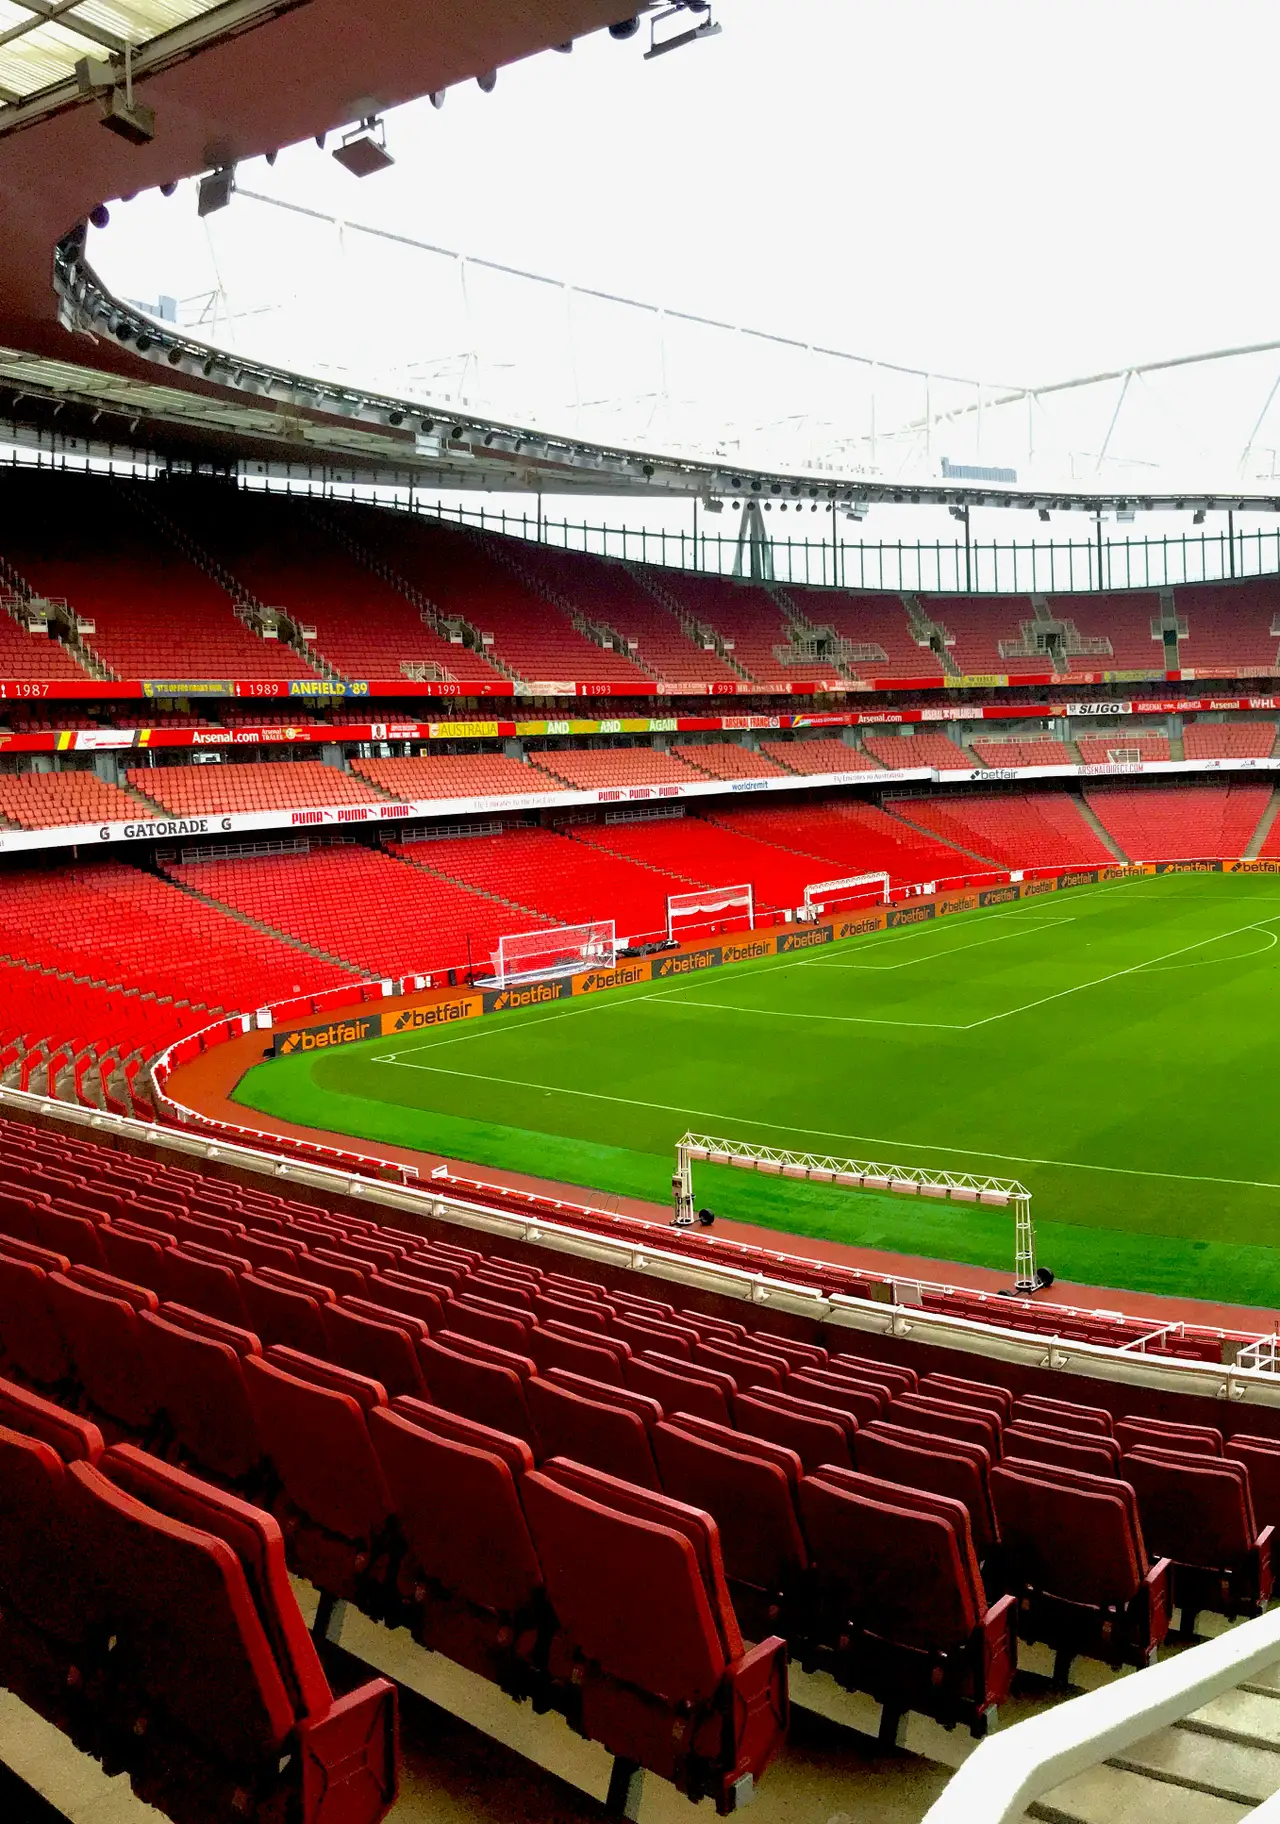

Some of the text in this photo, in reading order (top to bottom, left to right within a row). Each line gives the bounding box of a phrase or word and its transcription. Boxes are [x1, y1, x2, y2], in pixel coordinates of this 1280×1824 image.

[15, 684, 49, 696] 1987
[249, 684, 279, 695] 1989
[291, 682, 368, 695] ANFIELD '89
[437, 685, 461, 695] 1991
[591, 685, 611, 695] 1993
[1079, 703, 1119, 714] SLIGO
[1210, 700, 1240, 709] Arsenal
[1250, 698, 1277, 708] WHL
[649, 719, 677, 731] AGAIN
[858, 714, 902, 723] Arsenal.com
[441, 723, 497, 736] AUSTRALIA
[547, 721, 570, 734] AND
[600, 720, 621, 733] AND
[192, 730, 259, 744] Arsenal.com
[981, 769, 1018, 779] betfair
[659, 787, 678, 797] PUMA
[732, 781, 768, 791] worldremit
[598, 790, 620, 801] PUMA
[629, 788, 650, 799] PUMA
[292, 811, 322, 824] PUMA
[338, 808, 367, 821] PUMA
[380, 805, 409, 817] PUMA
[124, 819, 209, 838] GATORADE
[221, 818, 232, 830] G
[100, 827, 110, 840] G
[1111, 866, 1148, 878] betfair
[1175, 863, 1215, 873] betfair
[1069, 872, 1094, 885] betfair
[1033, 879, 1056, 894] betfair
[990, 889, 1016, 905] betfair
[948, 896, 975, 912] betfair
[901, 907, 930, 924] betfair
[850, 917, 881, 935] betfair
[789, 928, 830, 947] betfair
[734, 941, 769, 960] betfair
[673, 951, 715, 973] betfair
[596, 966, 643, 988] betfair
[510, 982, 562, 1007] betfair
[413, 1001, 471, 1026] betfair
[302, 1020, 369, 1049] betfair
